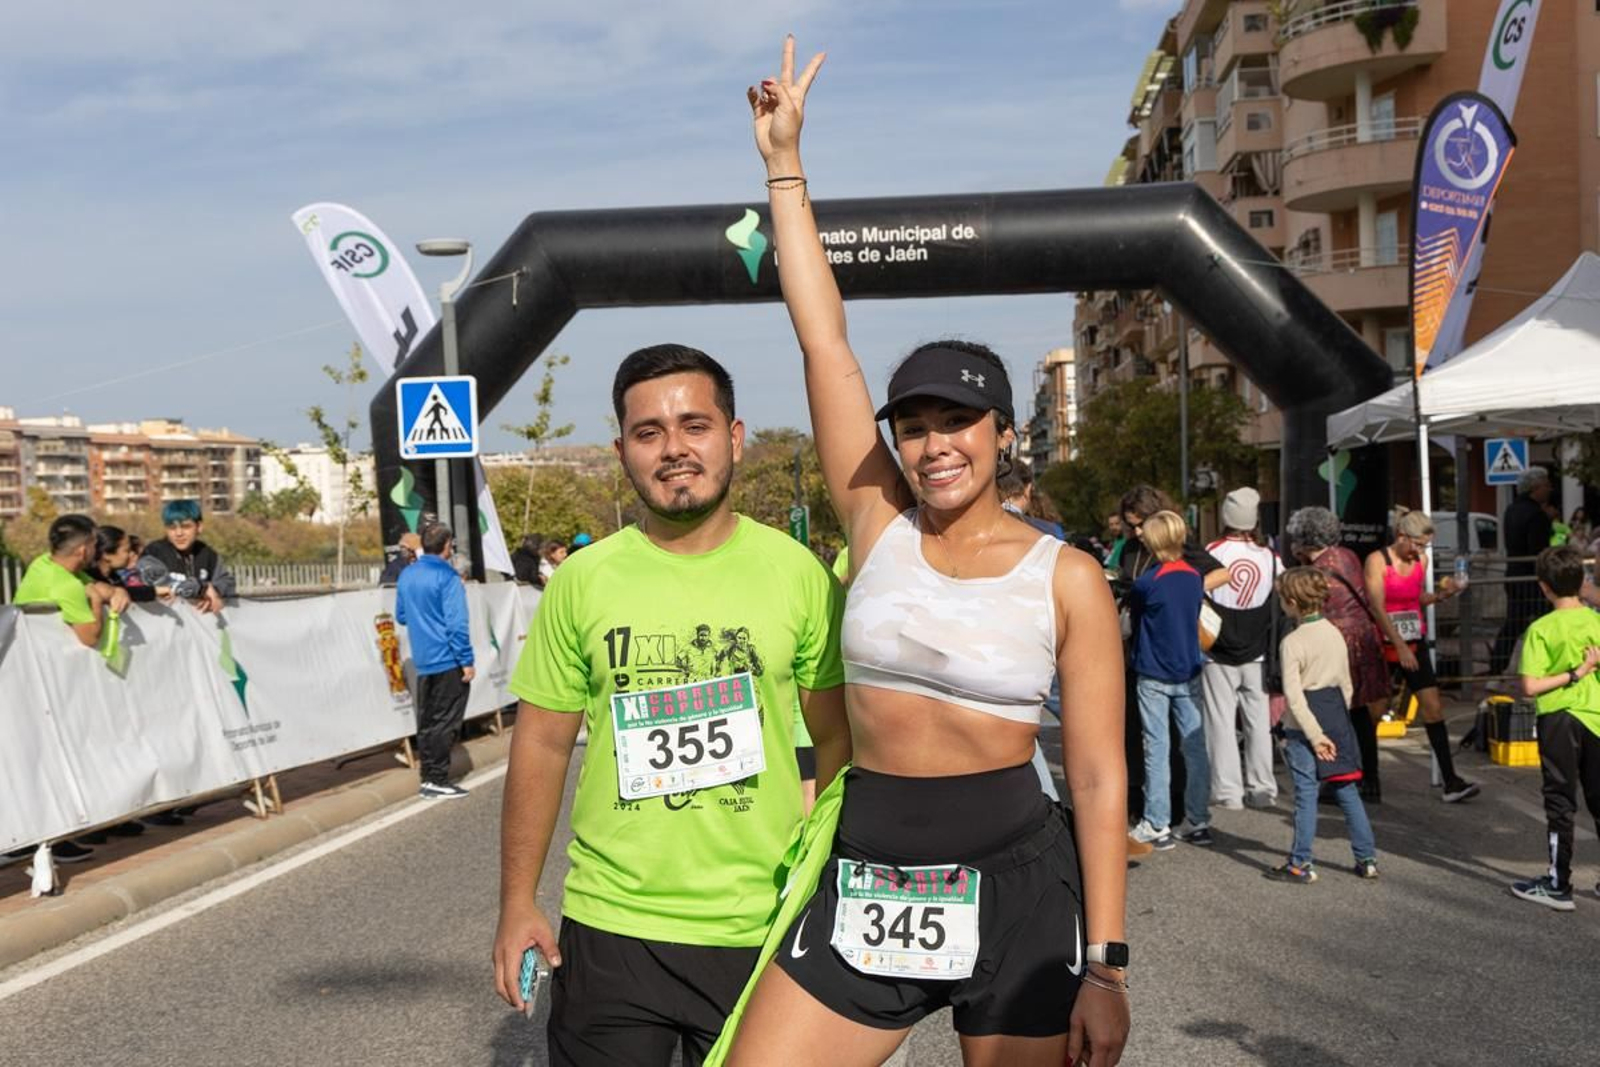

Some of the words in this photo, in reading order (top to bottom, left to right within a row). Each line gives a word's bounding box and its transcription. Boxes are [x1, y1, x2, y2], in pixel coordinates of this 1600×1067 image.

[862, 224, 947, 244] Municipal
[951, 224, 974, 240] de
[858, 249, 881, 263] de
[885, 244, 928, 262] Jaén
[603, 626, 632, 670] 17
[634, 635, 677, 667] XI
[649, 678, 743, 705] CARRERA
[650, 690, 744, 717] POPULAR
[648, 717, 733, 770] 355
[613, 802, 640, 811] 2024
[863, 902, 946, 951] 345
